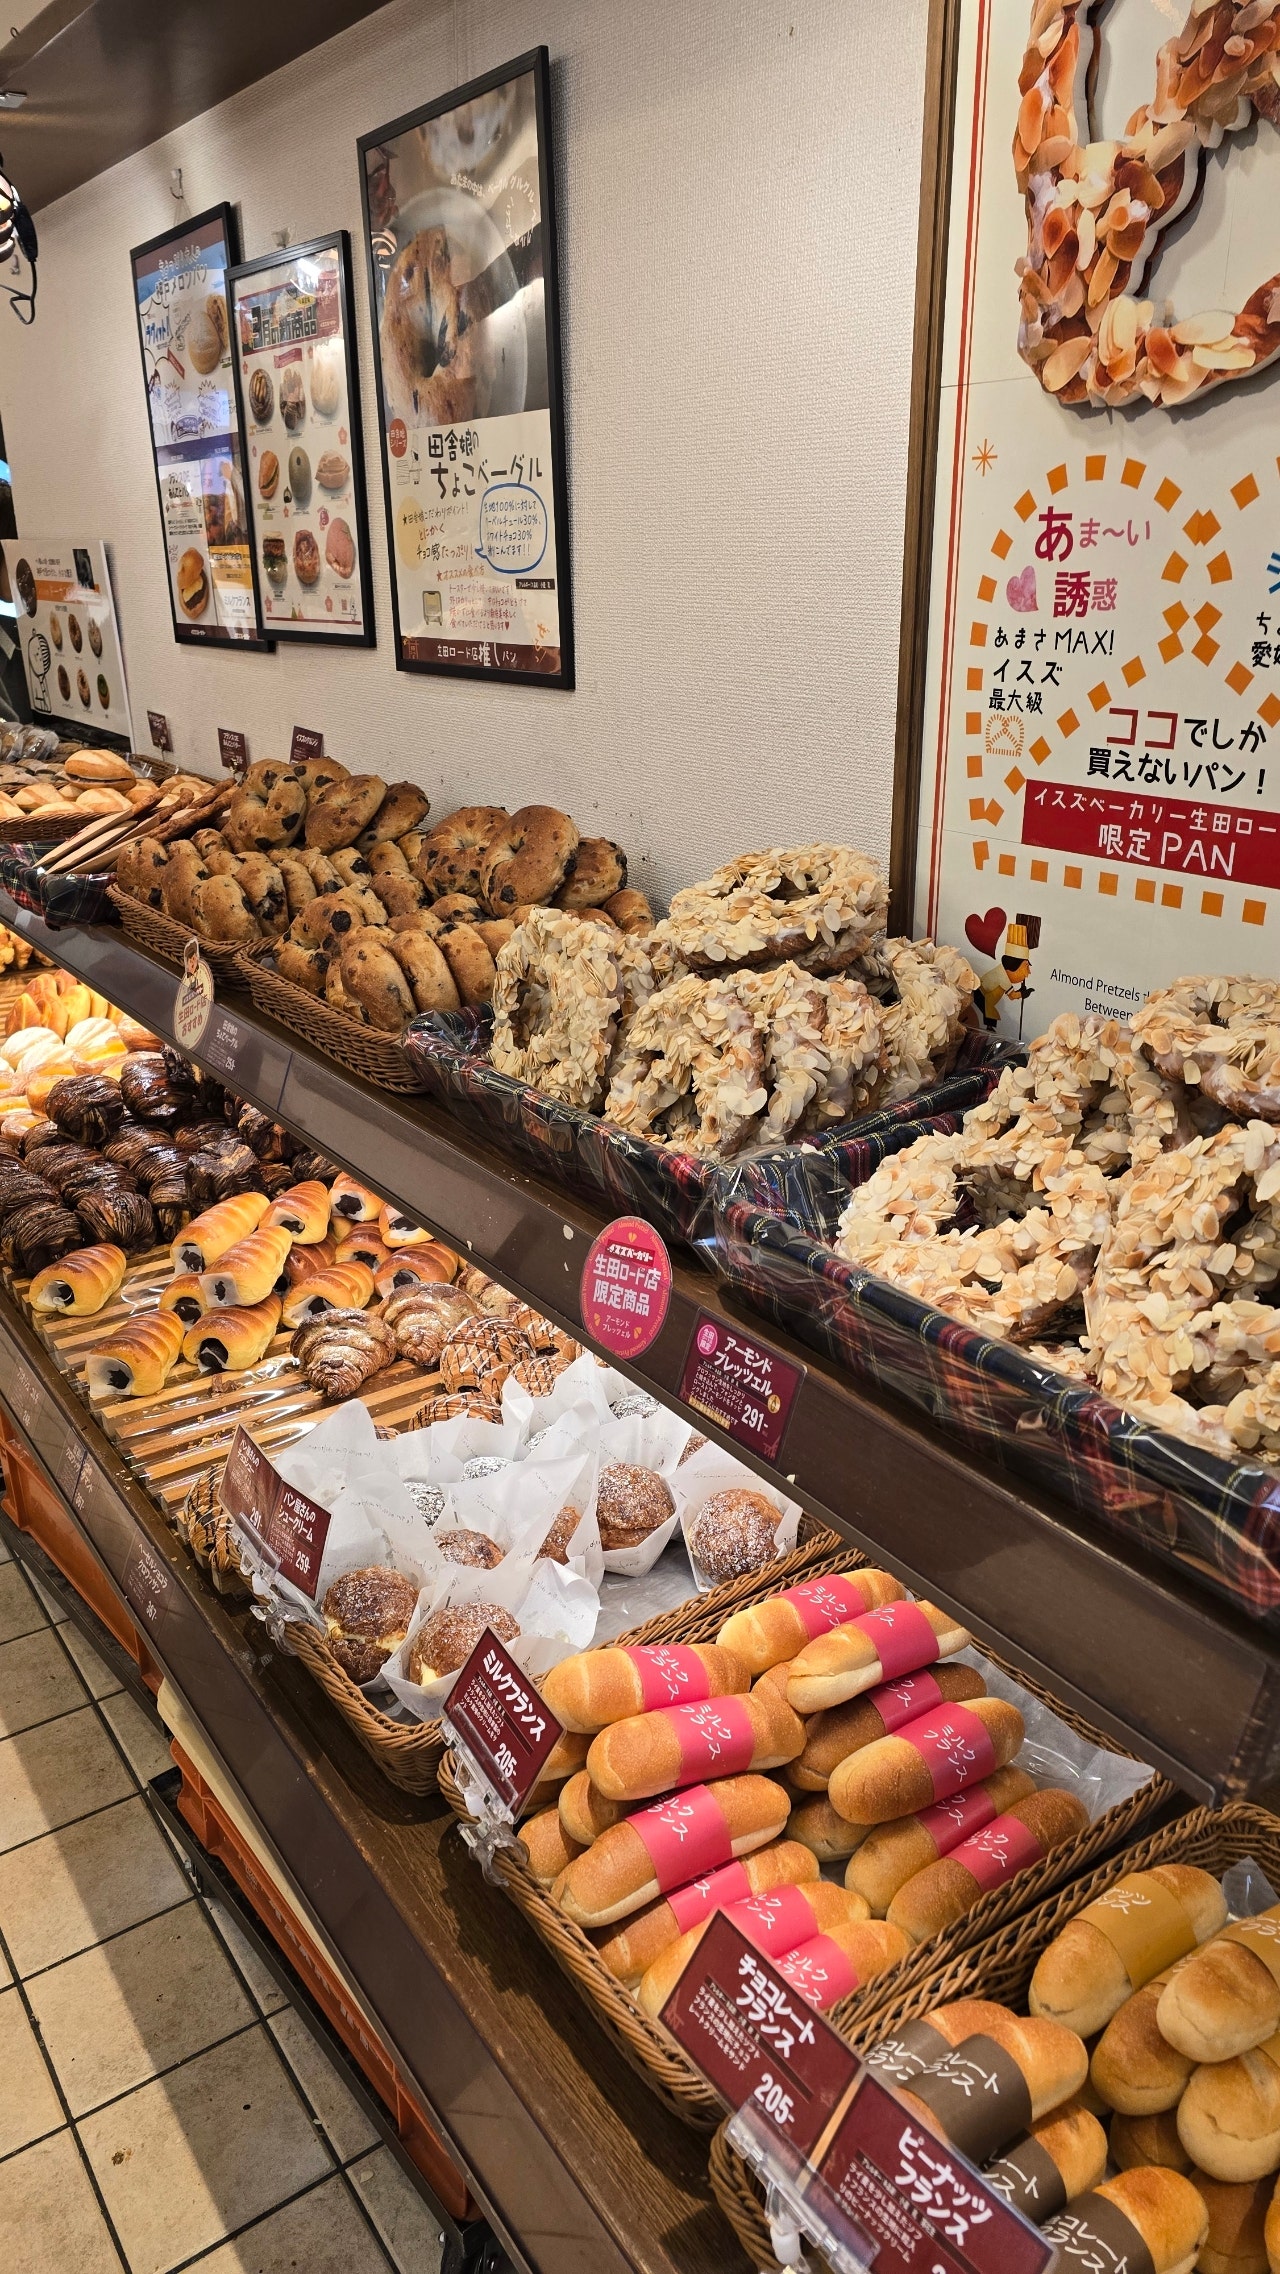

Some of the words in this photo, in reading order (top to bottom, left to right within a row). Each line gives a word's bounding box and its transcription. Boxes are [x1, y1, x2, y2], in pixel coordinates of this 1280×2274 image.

[428, 428, 479, 461] 田舎娘の
[431, 454, 543, 499] ちょこベーグル
[419, 523, 445, 541] とにかく
[1053, 570, 1118, 618] 誘惑
[993, 659, 1062, 686] イスズ
[989, 688, 1043, 714] 最大級
[1107, 707, 1266, 753] ココでしか
[1087, 748, 1265, 794] 買えないパン!
[1050, 968, 1093, 989] Almond
[1096, 979, 1140, 1001] Pretzels
[182, 1012, 203, 1037] おすすめ
[606, 1243, 653, 1262] イスズベーカリー
[593, 1253, 662, 1291] 生田ロード店
[593, 1279, 650, 1317] 限定商品
[602, 1323, 631, 1339] プレッツェル
[605, 1315, 631, 1328] アーモンド
[714, 1351, 772, 1396] プレッツェル
[725, 1336, 773, 1374] アーモンド
[278, 1505, 313, 1543] シュークリーム
[283, 1492, 316, 1523] パン屋さんの
[138, 1559, 161, 1594] クロワッサン
[816, 1586, 848, 1613] ミルク
[641, 1647, 681, 1701] フランス
[658, 1649, 689, 1683] ミルク
[482, 1649, 546, 1742] ミルクフランス
[680, 1705, 722, 1760] フランス
[700, 1705, 732, 1740] ミルク
[924, 1730, 968, 1782] フランス
[942, 1725, 975, 1760] ミルク
[786, 1951, 828, 1981] ミルク
[738, 1953, 816, 2045] チョコレート
[689, 2003, 746, 2071] レートクリームをサンド
[694, 1995, 751, 2063] フランスの生地にチョコ
[736, 1983, 795, 2058] フランス
[898, 2126, 993, 2224] ピーナッツ
[895, 2160, 969, 2246] フランス
